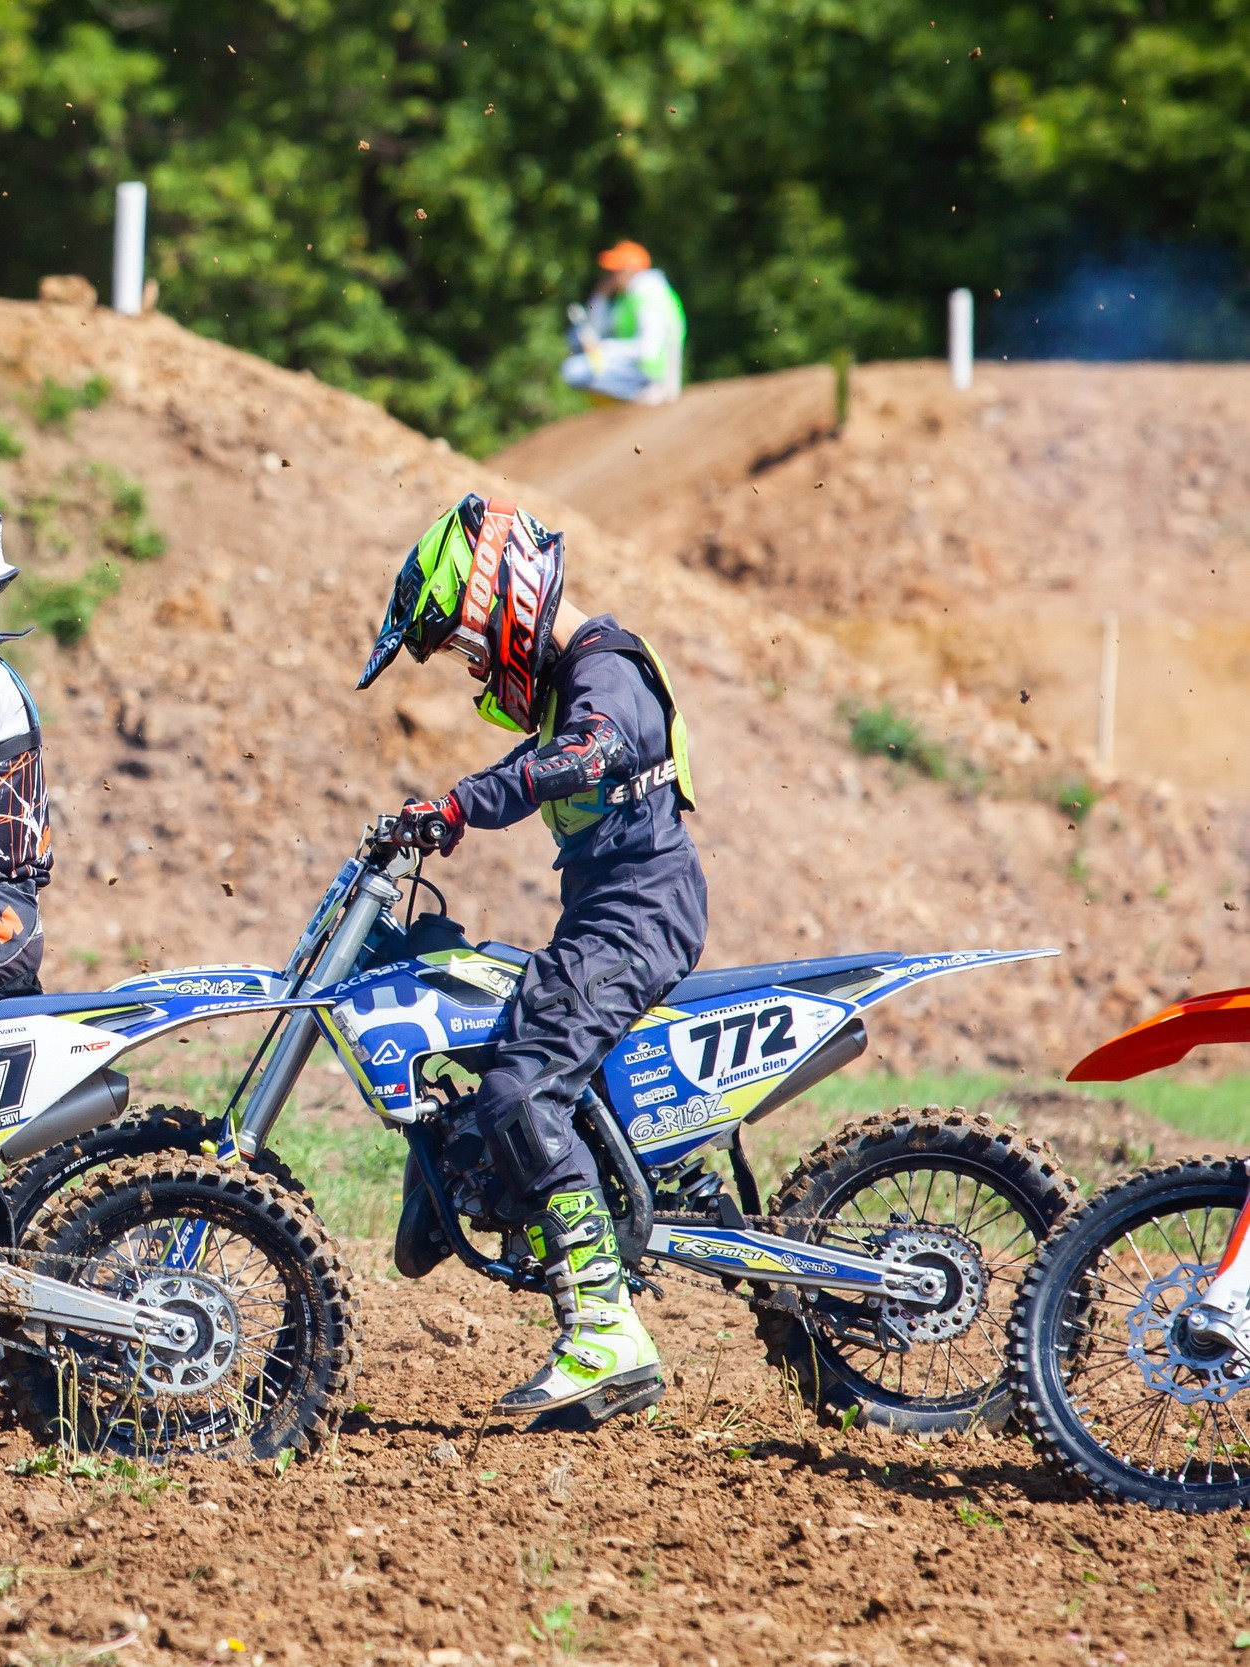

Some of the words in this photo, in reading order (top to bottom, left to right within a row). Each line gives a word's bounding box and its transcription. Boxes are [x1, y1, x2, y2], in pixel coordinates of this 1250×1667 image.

[467, 514, 510, 628] 100%
[688, 1004, 798, 1082] 772
[626, 1047, 665, 1063] MOTOREX
[631, 1072, 654, 1084] Twin
[655, 1067, 671, 1078] Air
[716, 1067, 760, 1088] Antonov
[762, 1057, 788, 1072] Gleb
[635, 1086, 675, 1102] GoPro
[676, 1240, 763, 1261] Renthal
[795, 1257, 837, 1274] brembo
